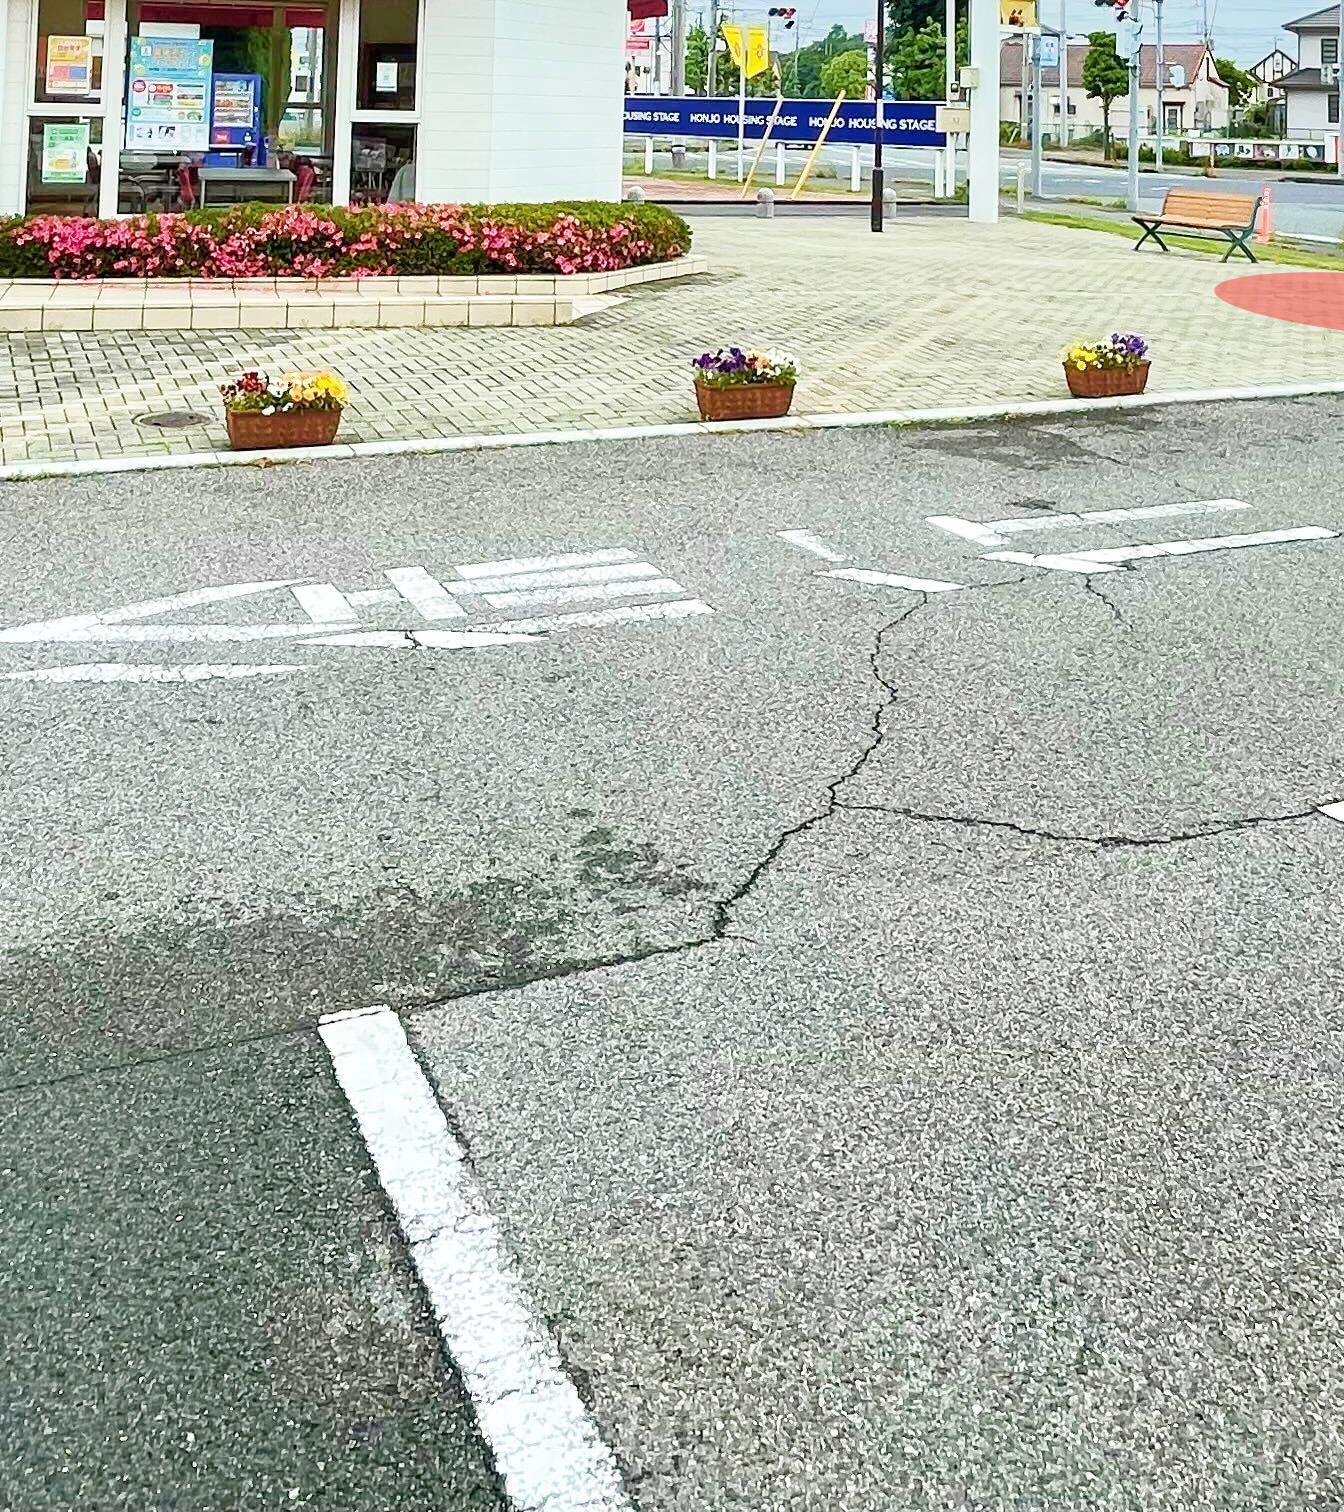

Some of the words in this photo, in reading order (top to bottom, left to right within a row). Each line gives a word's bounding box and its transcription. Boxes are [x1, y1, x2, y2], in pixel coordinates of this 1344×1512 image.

[653, 112, 680, 123] STAGE
[690, 113, 720, 124] HONJO
[899, 118, 936, 131] STAGE
